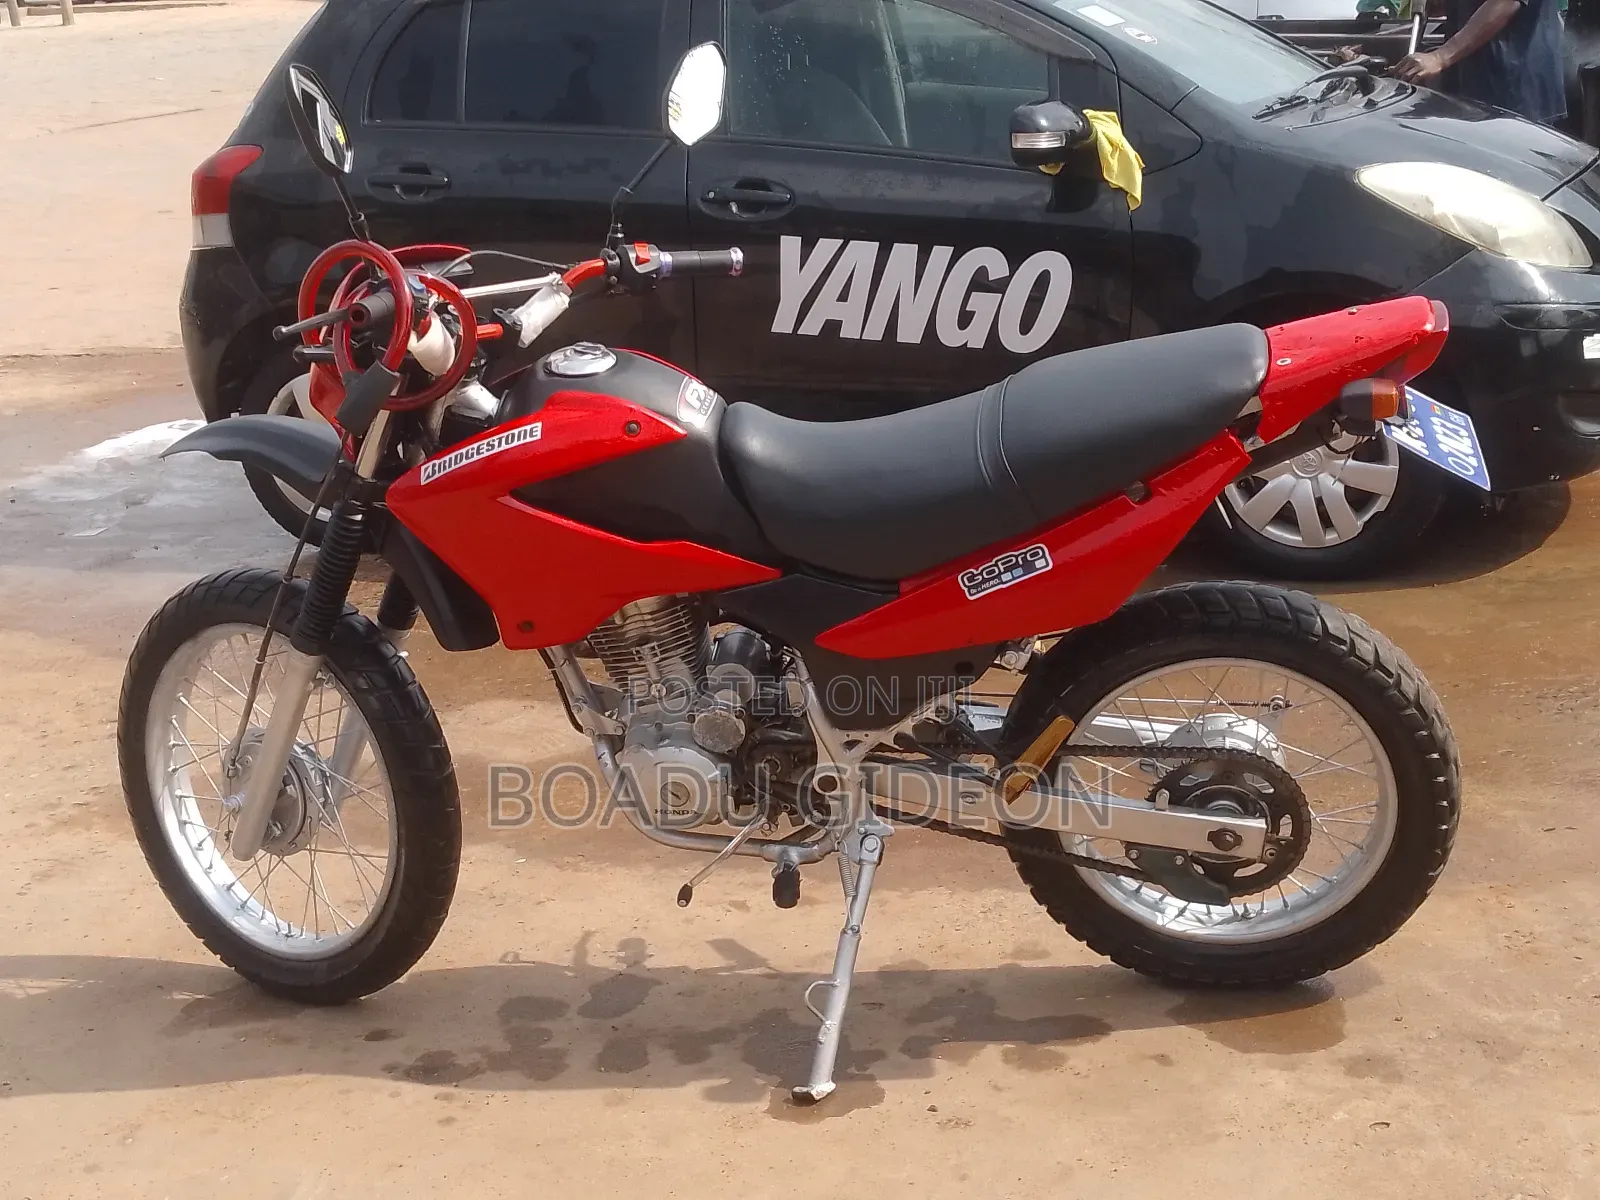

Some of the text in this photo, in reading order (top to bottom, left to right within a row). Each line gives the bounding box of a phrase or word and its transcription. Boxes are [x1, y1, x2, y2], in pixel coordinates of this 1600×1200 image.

[770, 235, 1073, 354] YANGO
[423, 425, 539, 482] BRIDGESTONE
[963, 548, 1043, 586] GoPro
[654, 808, 698, 816] HONDA
